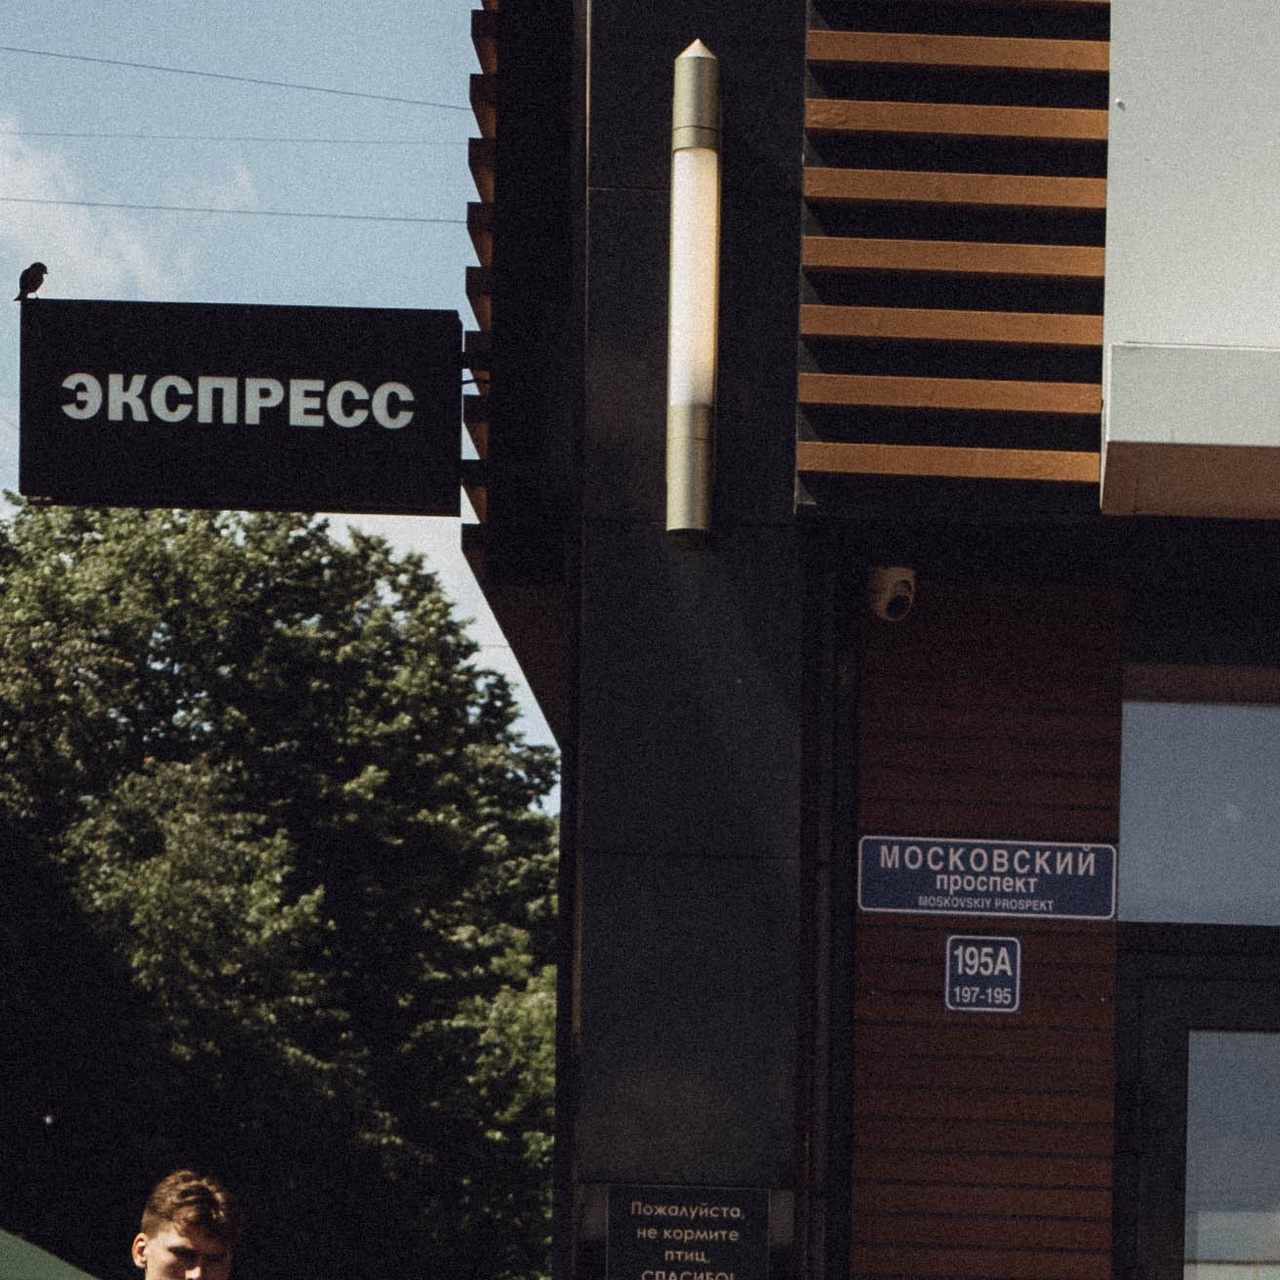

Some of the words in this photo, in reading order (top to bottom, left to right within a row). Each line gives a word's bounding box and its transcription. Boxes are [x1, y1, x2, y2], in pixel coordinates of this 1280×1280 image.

[61, 372, 415, 430] ЭКСПРЕСС
[880, 844, 1097, 876] МОСКОВСКИЙ
[936, 874, 1038, 895] проспект
[918, 896, 992, 909] MOSKOVSKIY
[995, 898, 1054, 912] PROSPEKT
[953, 987, 1012, 1005] 197-195
[631, 1201, 745, 1220] Пожалуйста,
[637, 1228, 658, 1239] не
[663, 1229, 740, 1243] кормите
